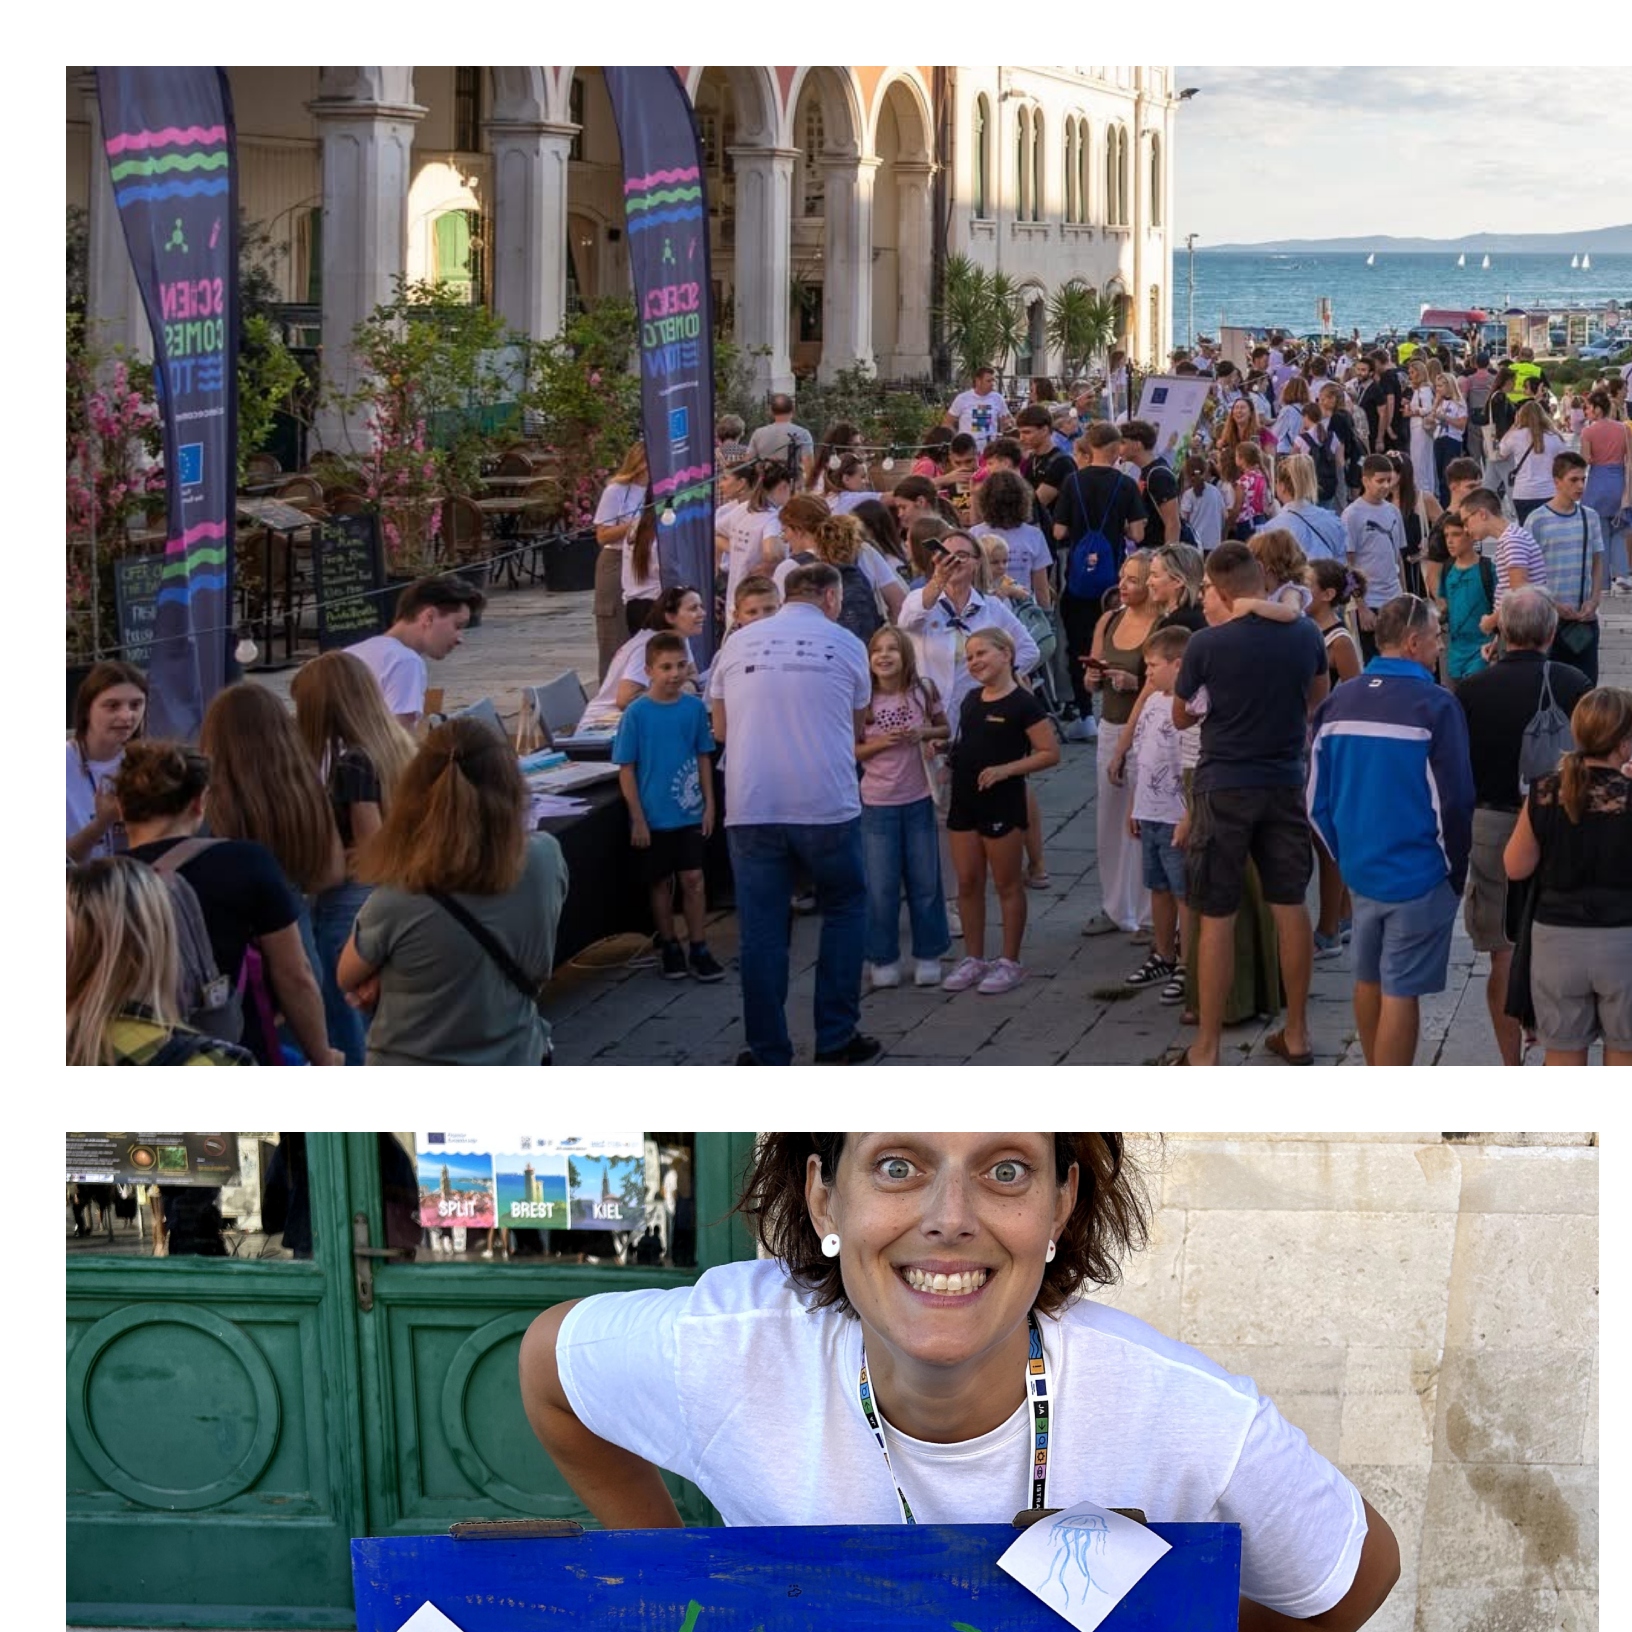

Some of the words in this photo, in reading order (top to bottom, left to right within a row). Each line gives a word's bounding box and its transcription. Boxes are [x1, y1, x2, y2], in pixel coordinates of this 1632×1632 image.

[438, 1202, 477, 1217] SPLIT
[510, 1202, 556, 1219] BREST
[592, 1203, 624, 1220] KIEL
